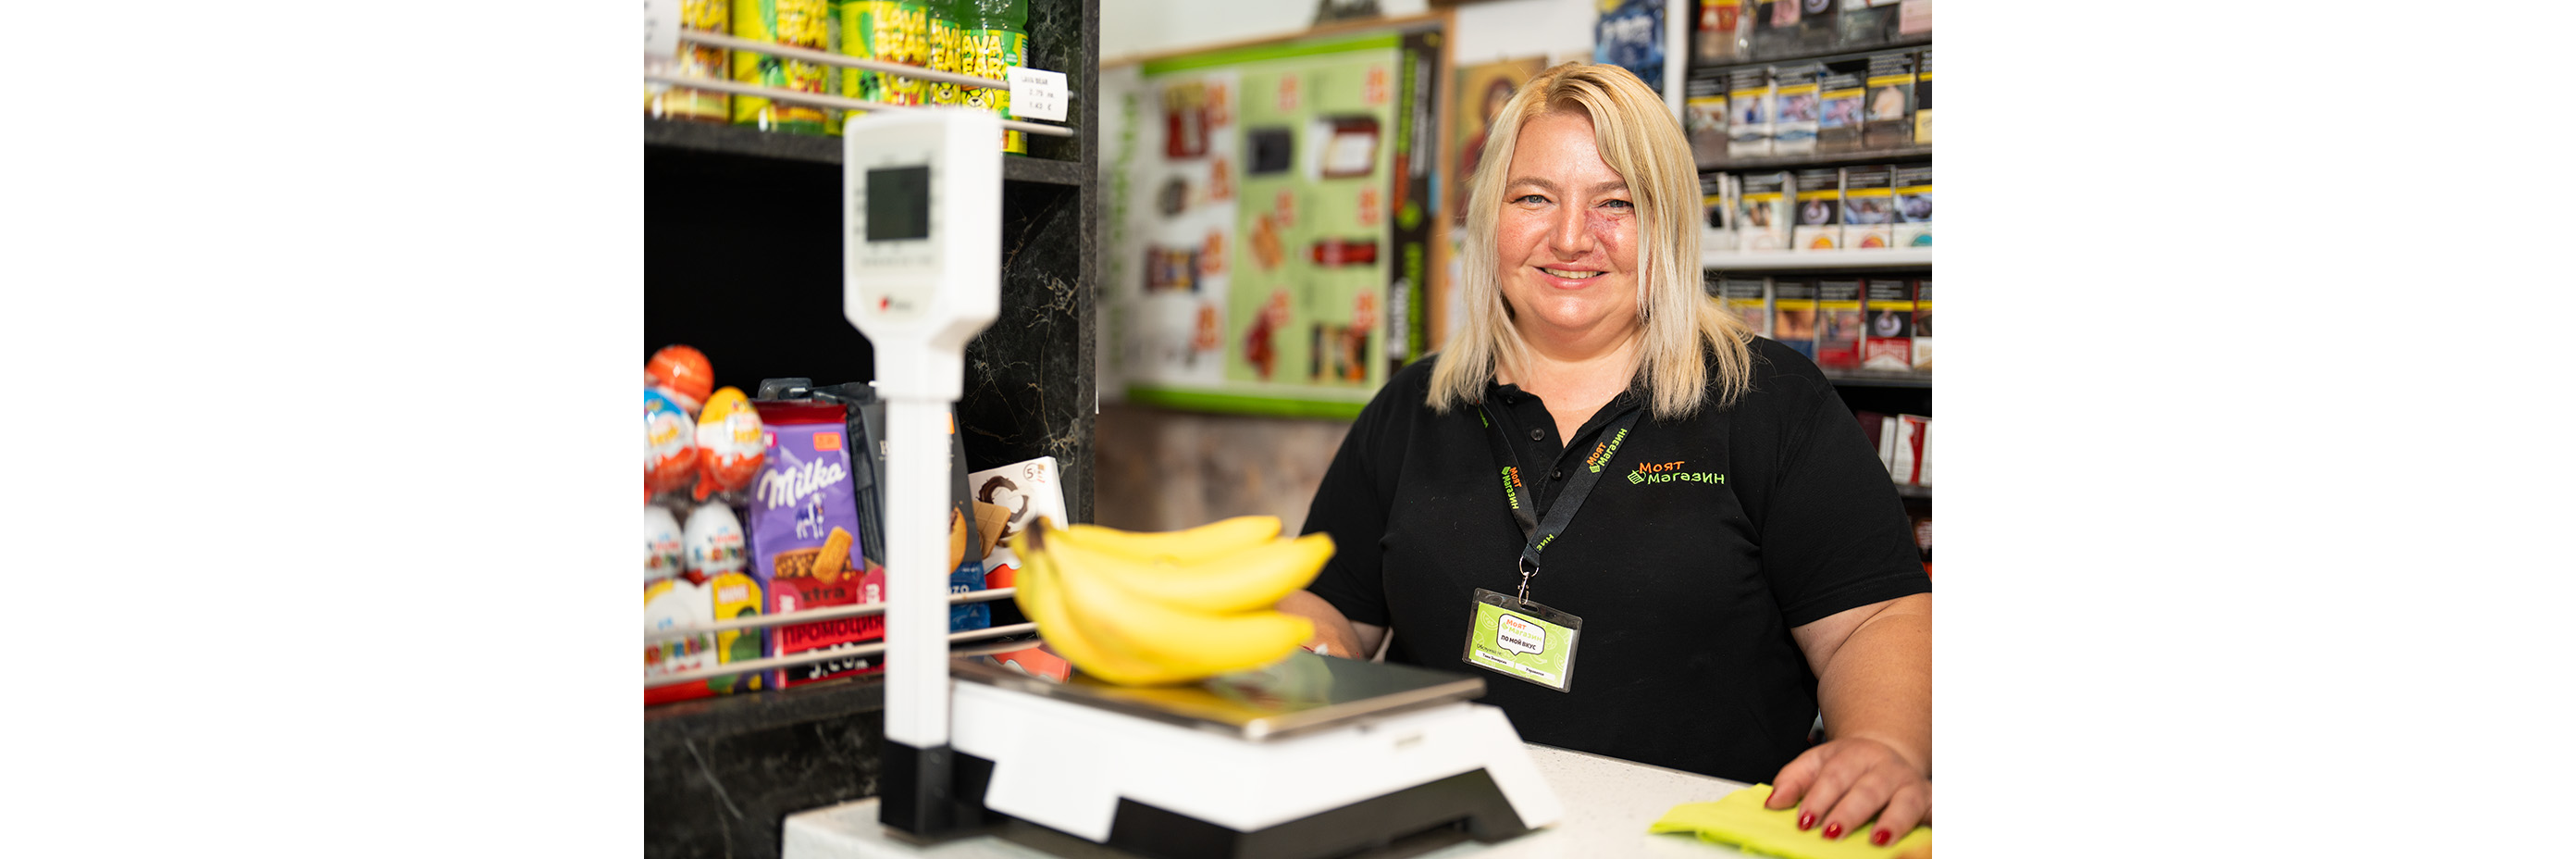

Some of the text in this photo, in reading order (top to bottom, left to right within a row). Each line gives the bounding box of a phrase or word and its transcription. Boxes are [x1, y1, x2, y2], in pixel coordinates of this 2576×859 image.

[1586, 442, 1607, 467] Моят
[1597, 428, 1628, 467] Магазин
[1509, 467, 1522, 488] Моят
[1639, 461, 1686, 475] Моят
[757, 456, 847, 510] Milka
[1502, 474, 1519, 510] Магазин
[1505, 618, 1527, 629] Моят
[1509, 636, 1522, 646] МОЙ
[1522, 641, 1536, 650] ВКУС
